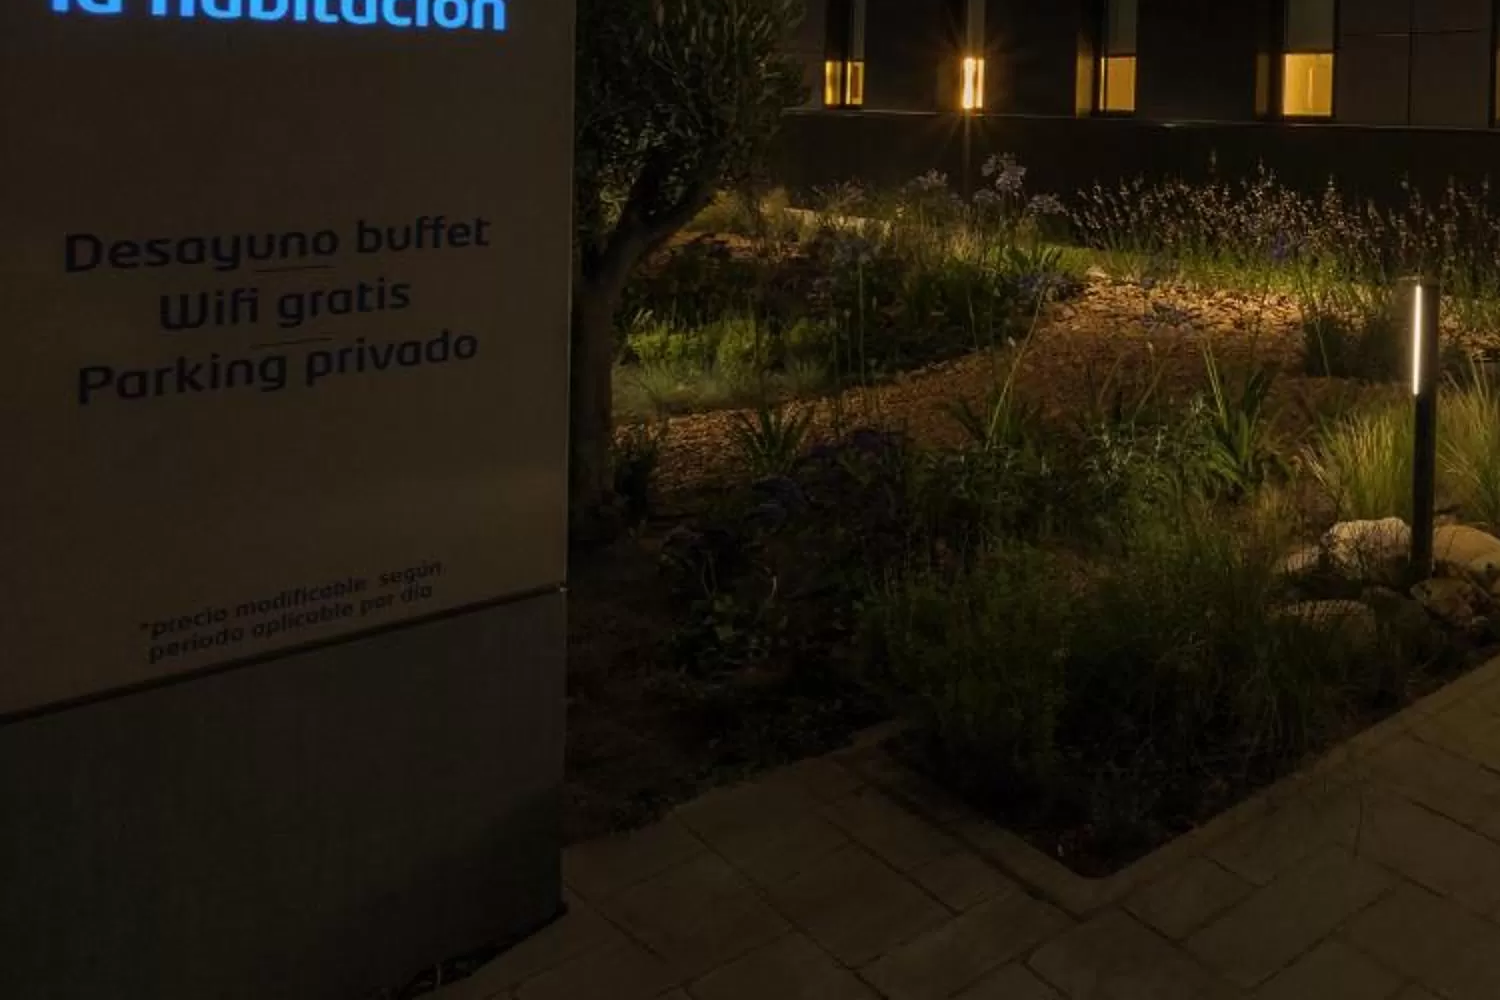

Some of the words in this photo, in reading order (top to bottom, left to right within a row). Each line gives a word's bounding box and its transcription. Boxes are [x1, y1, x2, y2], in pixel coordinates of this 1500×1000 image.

[64, 228, 339, 273] Desayuno
[355, 215, 492, 254] buffet
[159, 286, 259, 331] Wifi
[277, 277, 412, 329] gratis
[78, 353, 287, 405] Parking
[305, 329, 480, 387] privado
[236, 577, 368, 618] modificable
[253, 603, 354, 640] aplicable
